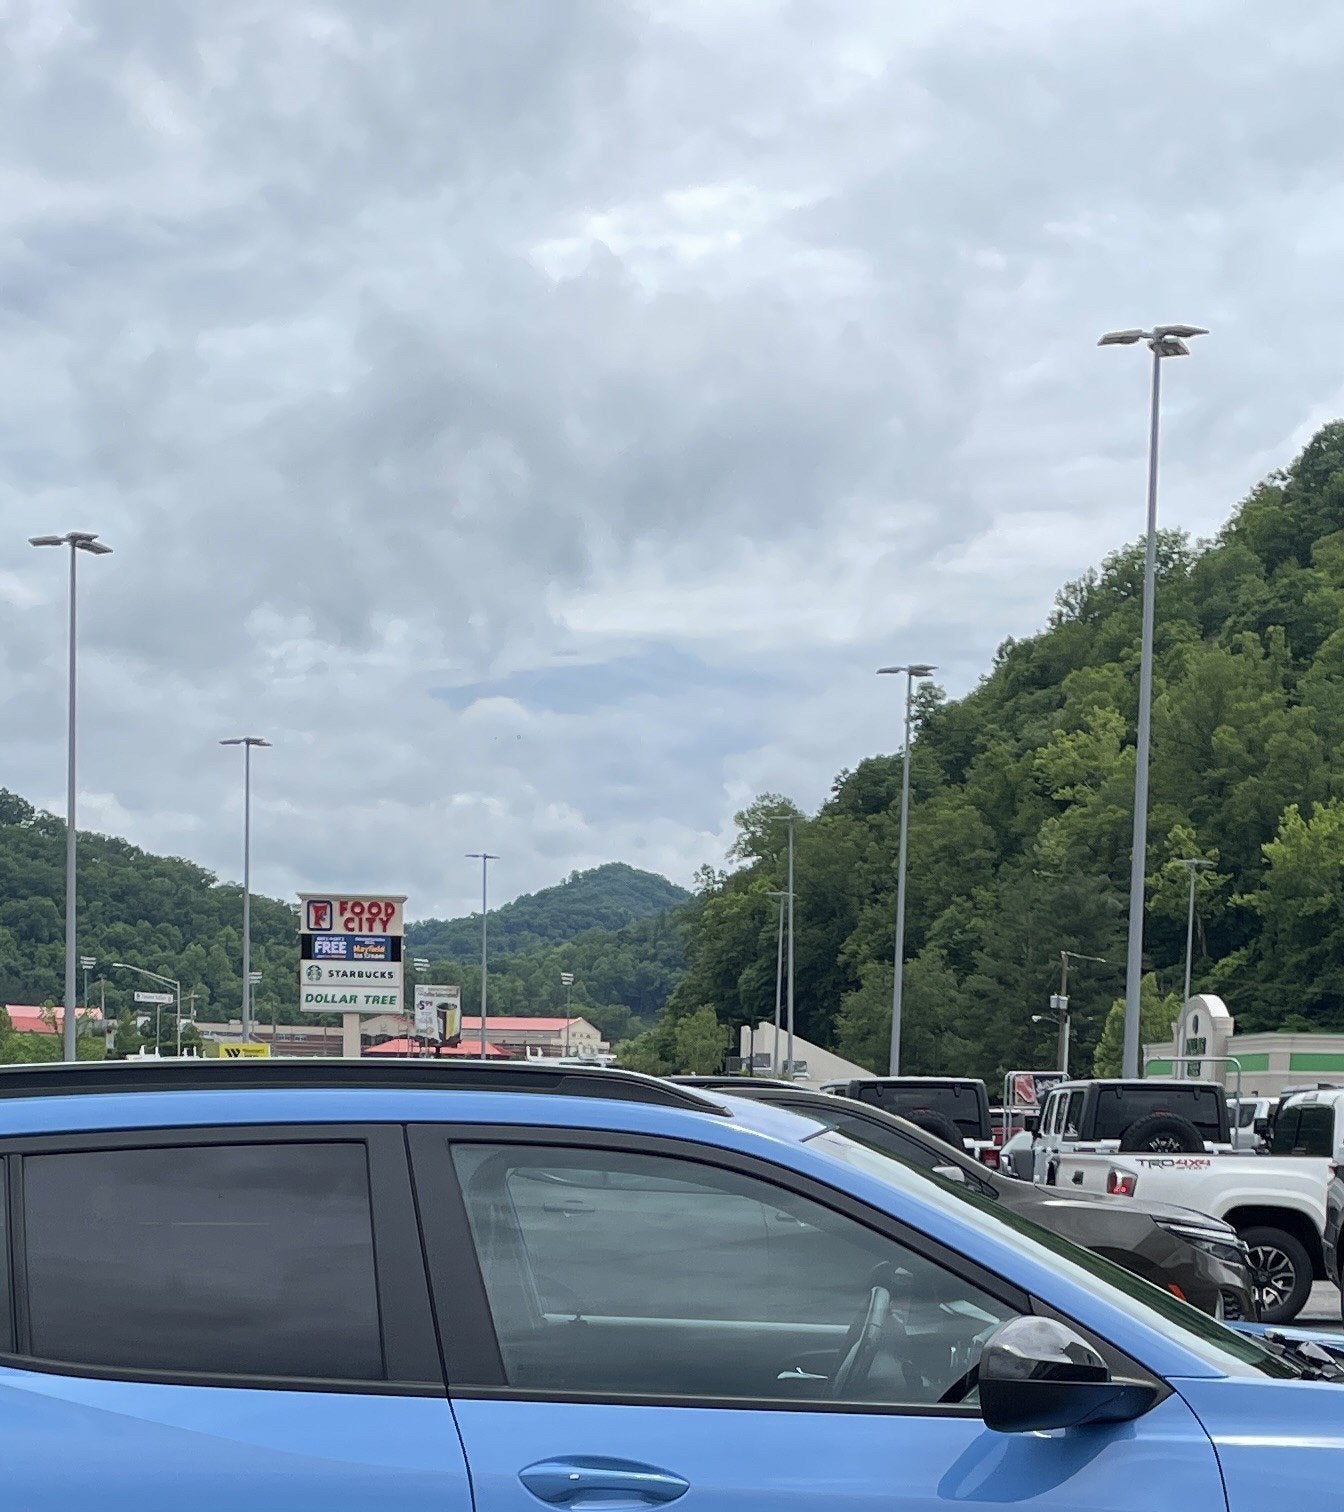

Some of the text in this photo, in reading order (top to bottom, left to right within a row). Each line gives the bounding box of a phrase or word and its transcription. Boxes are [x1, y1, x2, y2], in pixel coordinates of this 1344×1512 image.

[339, 900, 396, 919] FOOD
[343, 917, 392, 933] CITY
[314, 941, 347, 954] FREE
[328, 969, 394, 979] STARBUCKS
[305, 993, 397, 1005] DOLLAR TREE
